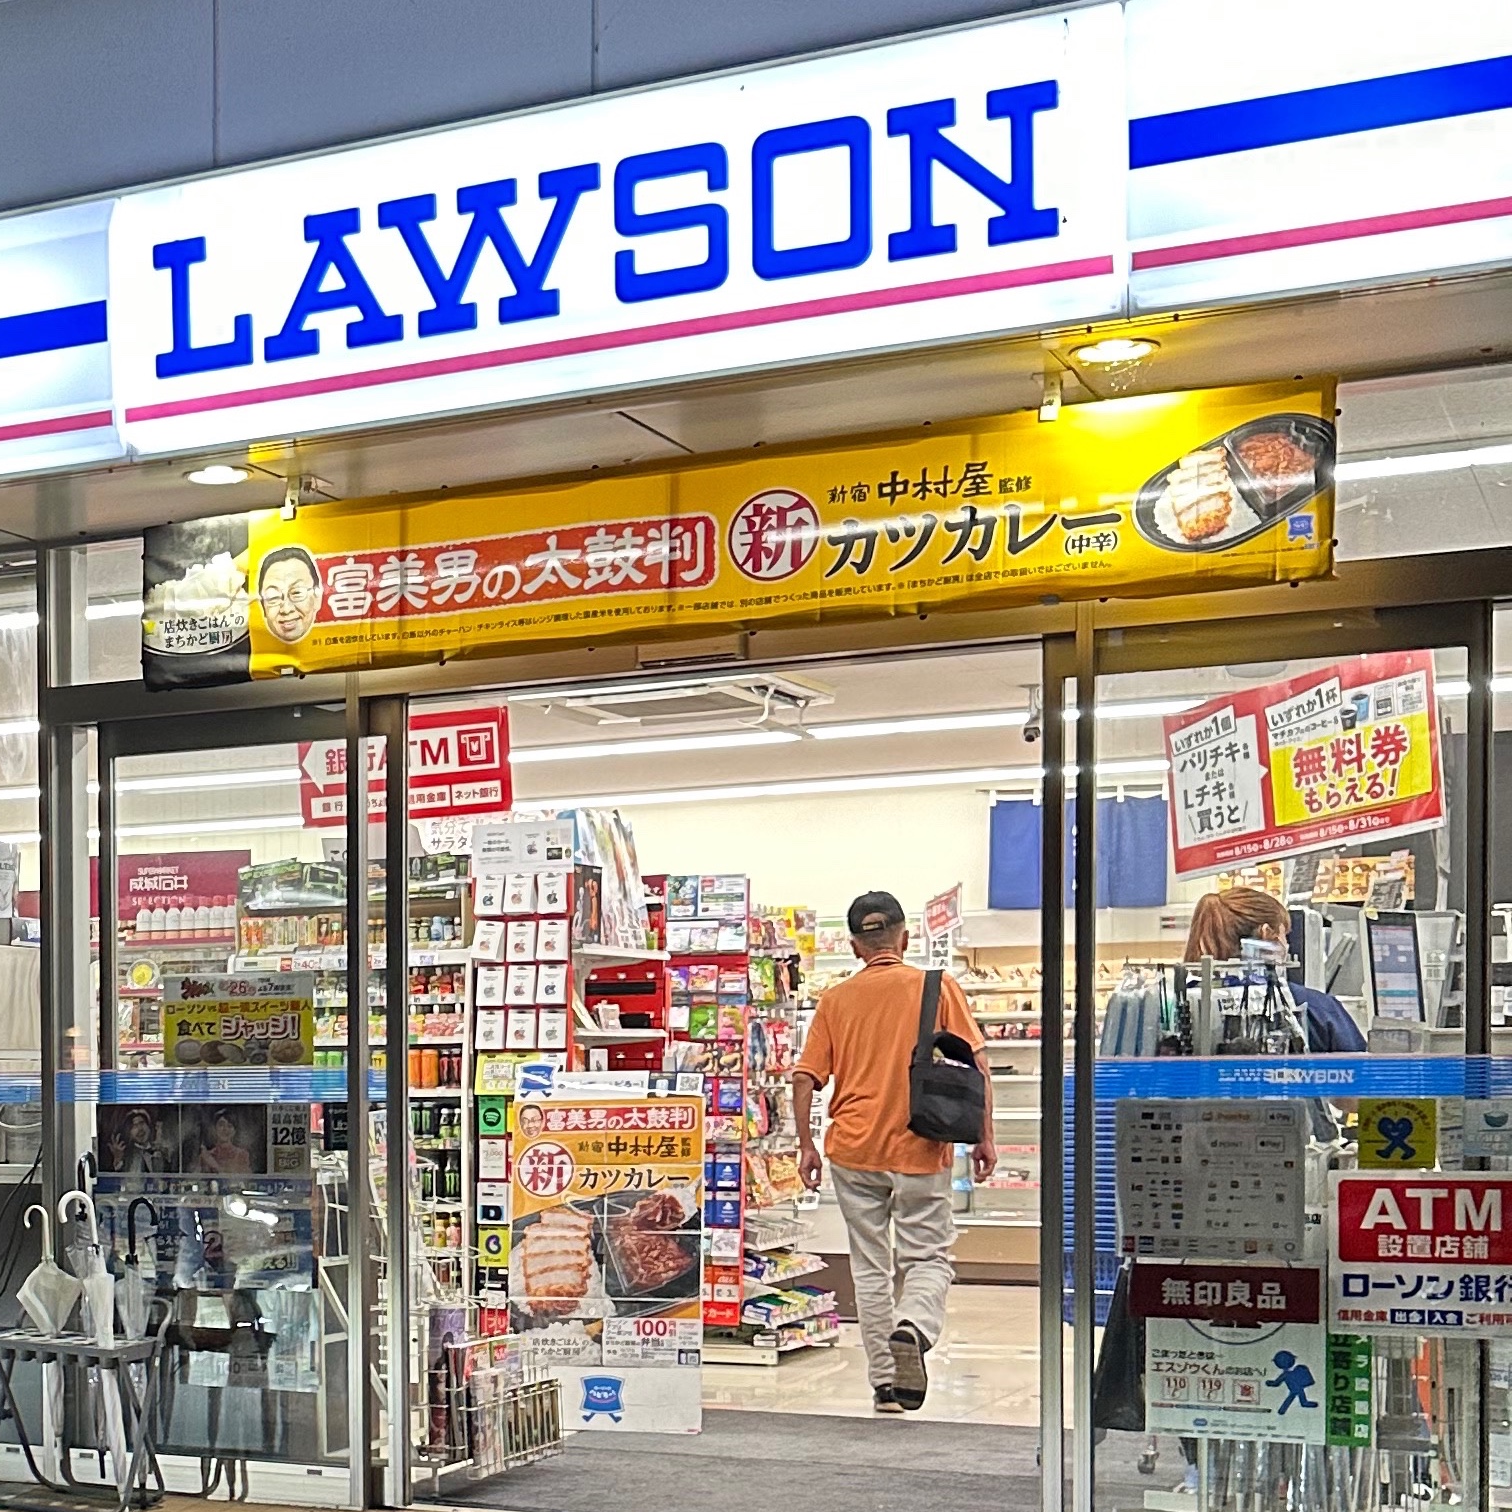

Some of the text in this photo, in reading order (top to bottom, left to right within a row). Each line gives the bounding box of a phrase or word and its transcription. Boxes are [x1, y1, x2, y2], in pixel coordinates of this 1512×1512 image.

[152, 80, 1059, 379] LAWSON
[827, 461, 1033, 507] 新宿 中村屋 監修
[738, 497, 810, 576] 新
[825, 503, 1122, 579] カツカレー
[1065, 531, 1119, 555] (中辛)
[326, 521, 706, 619] 富美男の太鼓判
[164, 630, 234, 648] まちかど厨房
[1271, 687, 1339, 727] いずれか1杯
[1292, 724, 1409, 788] 無料券
[454, 786, 499, 800] ネット銀行
[1183, 781, 1227, 810] Lチキ
[1304, 768, 1398, 813] もらえる!
[1197, 804, 1241, 834] 買うと
[177, 1013, 301, 1041] 食べて ジャッジ!
[546, 1107, 693, 1131] 富美男の太鼓判
[271, 1126, 307, 1145] 12億
[607, 1135, 679, 1158] 中村屋
[525, 1148, 569, 1192] 新
[578, 1167, 690, 1190] カツカレー
[1359, 1187, 1503, 1232] ATM
[1377, 1234, 1489, 1260] 設置店舗
[1161, 1277, 1287, 1310] 無印良品
[632, 1319, 667, 1337] 100
[1338, 1308, 1388, 1322] 信用金庫
[1394, 1310, 1423, 1324] 出金
[1431, 1310, 1460, 1324] 入金
